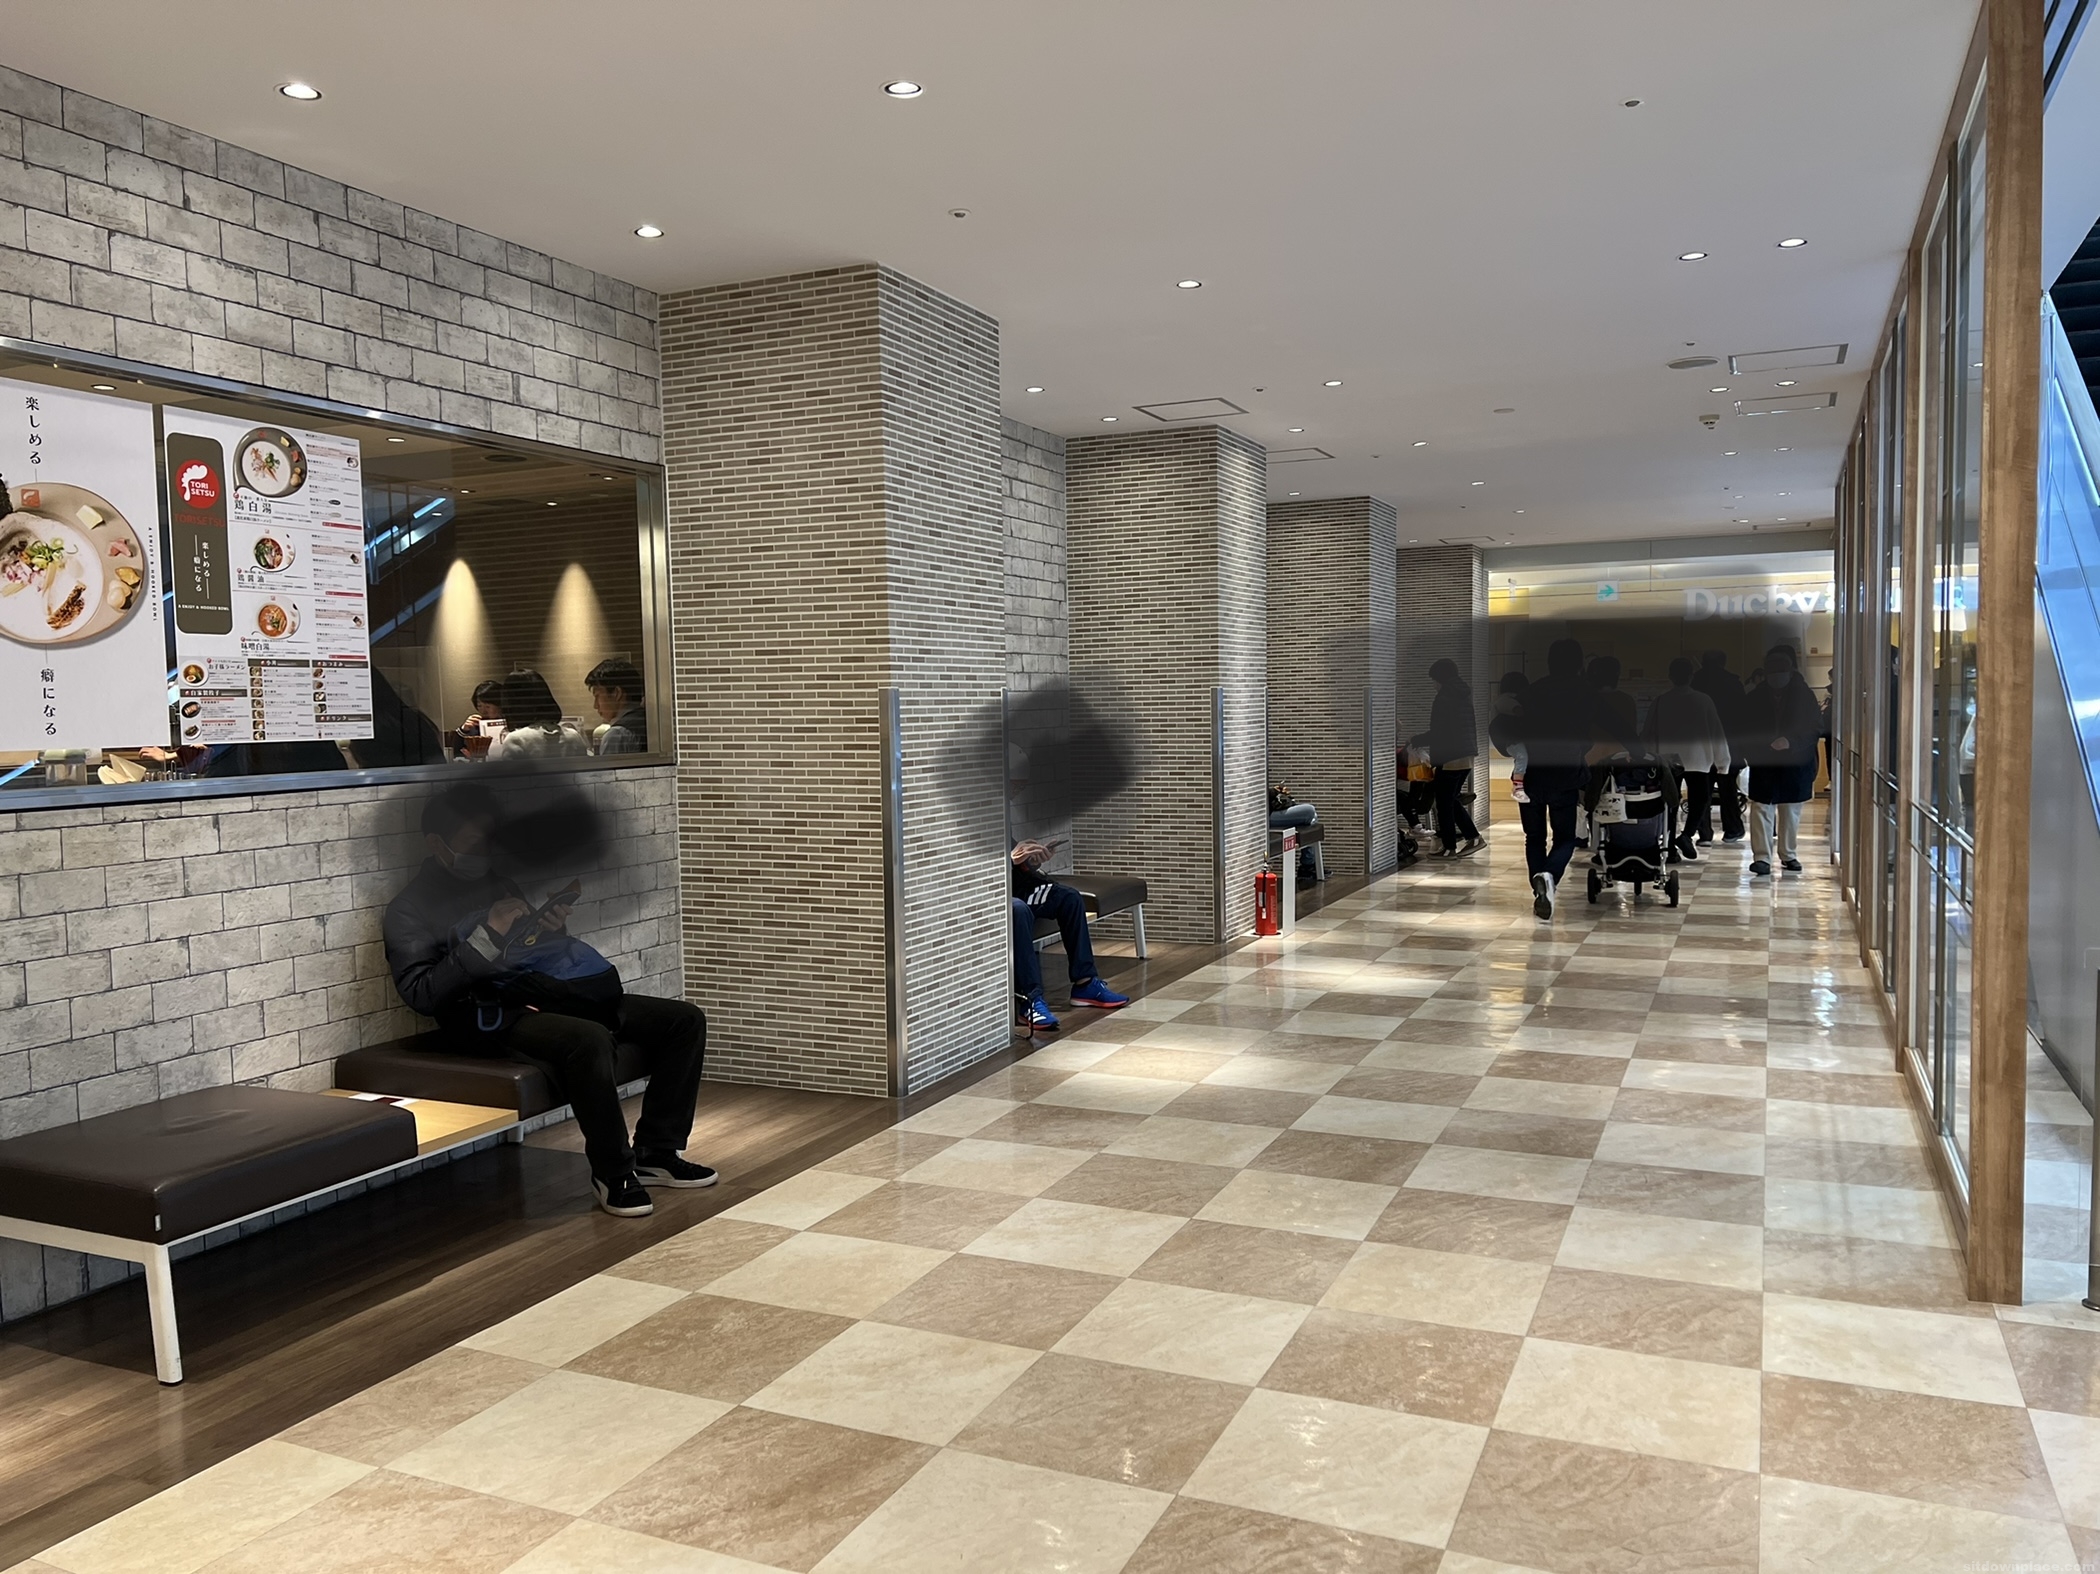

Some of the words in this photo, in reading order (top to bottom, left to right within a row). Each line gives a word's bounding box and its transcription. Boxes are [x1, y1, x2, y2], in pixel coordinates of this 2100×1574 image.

[25, 396, 42, 465] 楽しめる
[190, 480, 209, 490] TORI
[190, 488, 215, 498] SETSU
[234, 499, 272, 515] 鶏白湯
[174, 513, 226, 528] TORISETSU
[1683, 585, 1821, 630] Ducky
[40, 668, 57, 736] 癖になる
